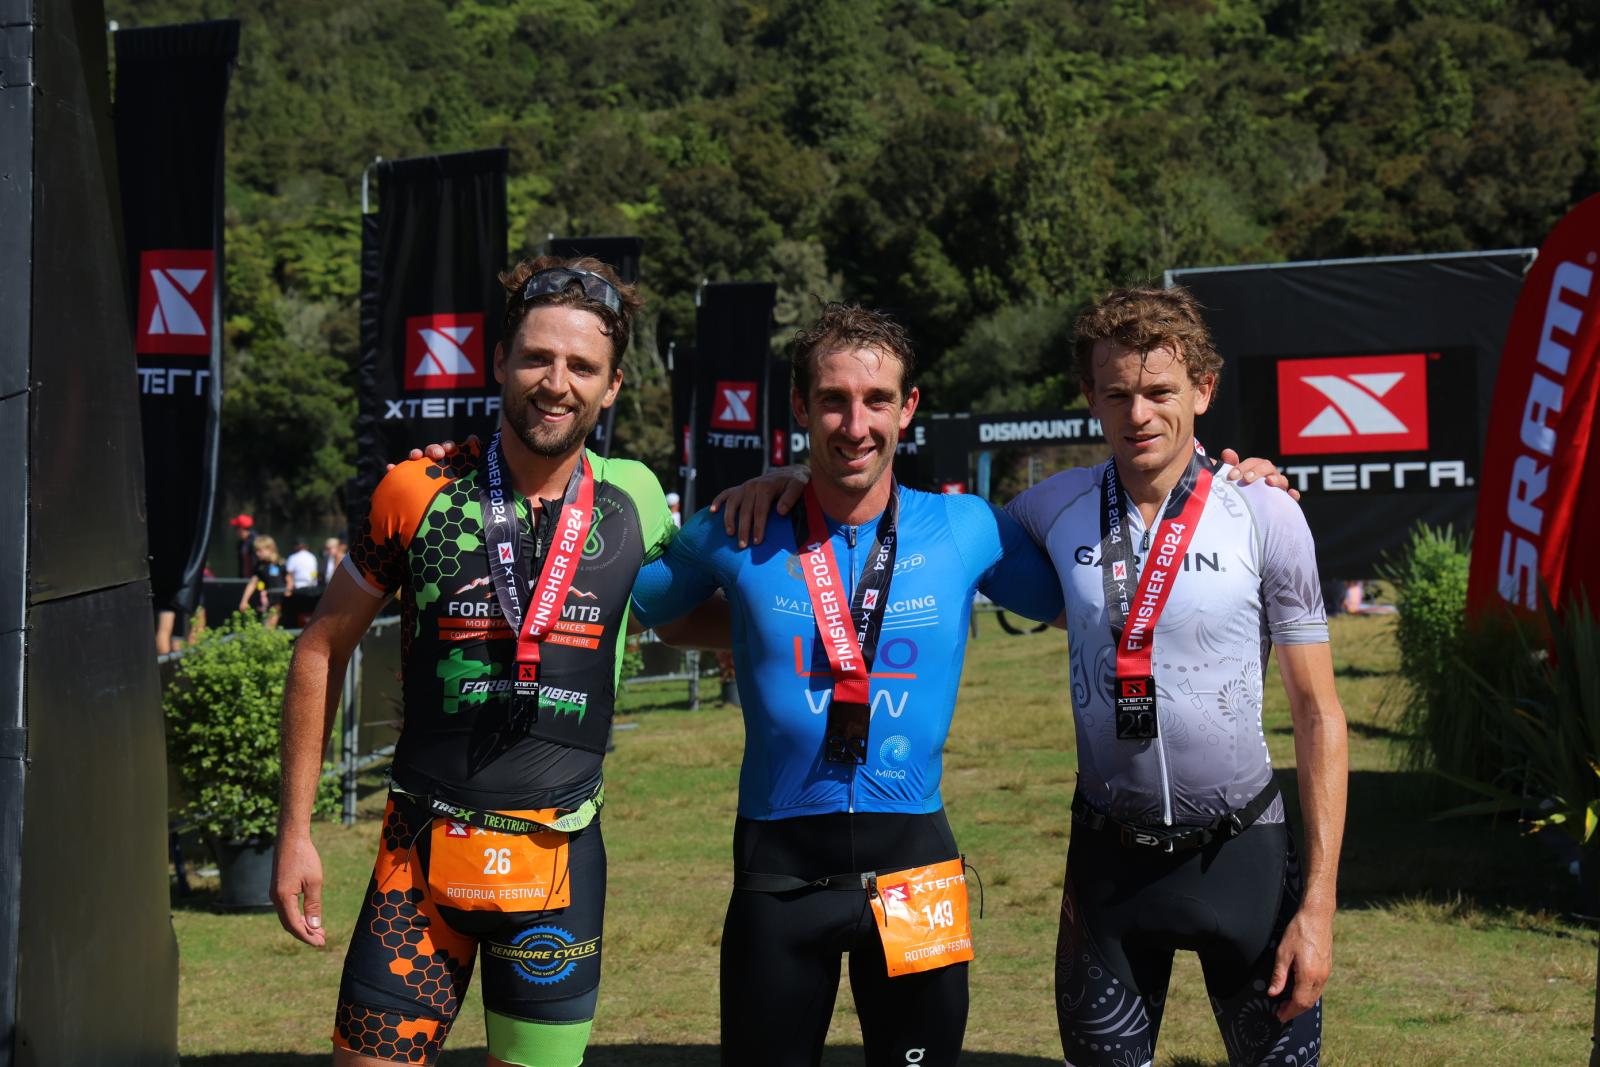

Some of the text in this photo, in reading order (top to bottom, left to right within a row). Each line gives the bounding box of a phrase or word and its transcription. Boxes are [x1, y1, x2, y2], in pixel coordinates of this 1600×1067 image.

[978, 418, 1085, 443] DISMOUNT
[1278, 459, 1467, 492] TERRA
[490, 489, 506, 524] 2024
[1108, 509, 1122, 545] 2024
[874, 535, 895, 571] 2024
[529, 507, 584, 637] FINISHER 2024
[1127, 522, 1186, 651] FINISHER 2024
[806, 541, 857, 672] FINISHER 2024
[884, 595, 936, 614] ACING
[551, 635, 571, 644] BIKE
[572, 638, 591, 647] HIRE
[483, 847, 512, 875] 26
[447, 886, 547, 900] ROTORUA FESTIVAL
[921, 900, 954, 930] 149
[490, 942, 597, 959] KENMORE CYCLES
